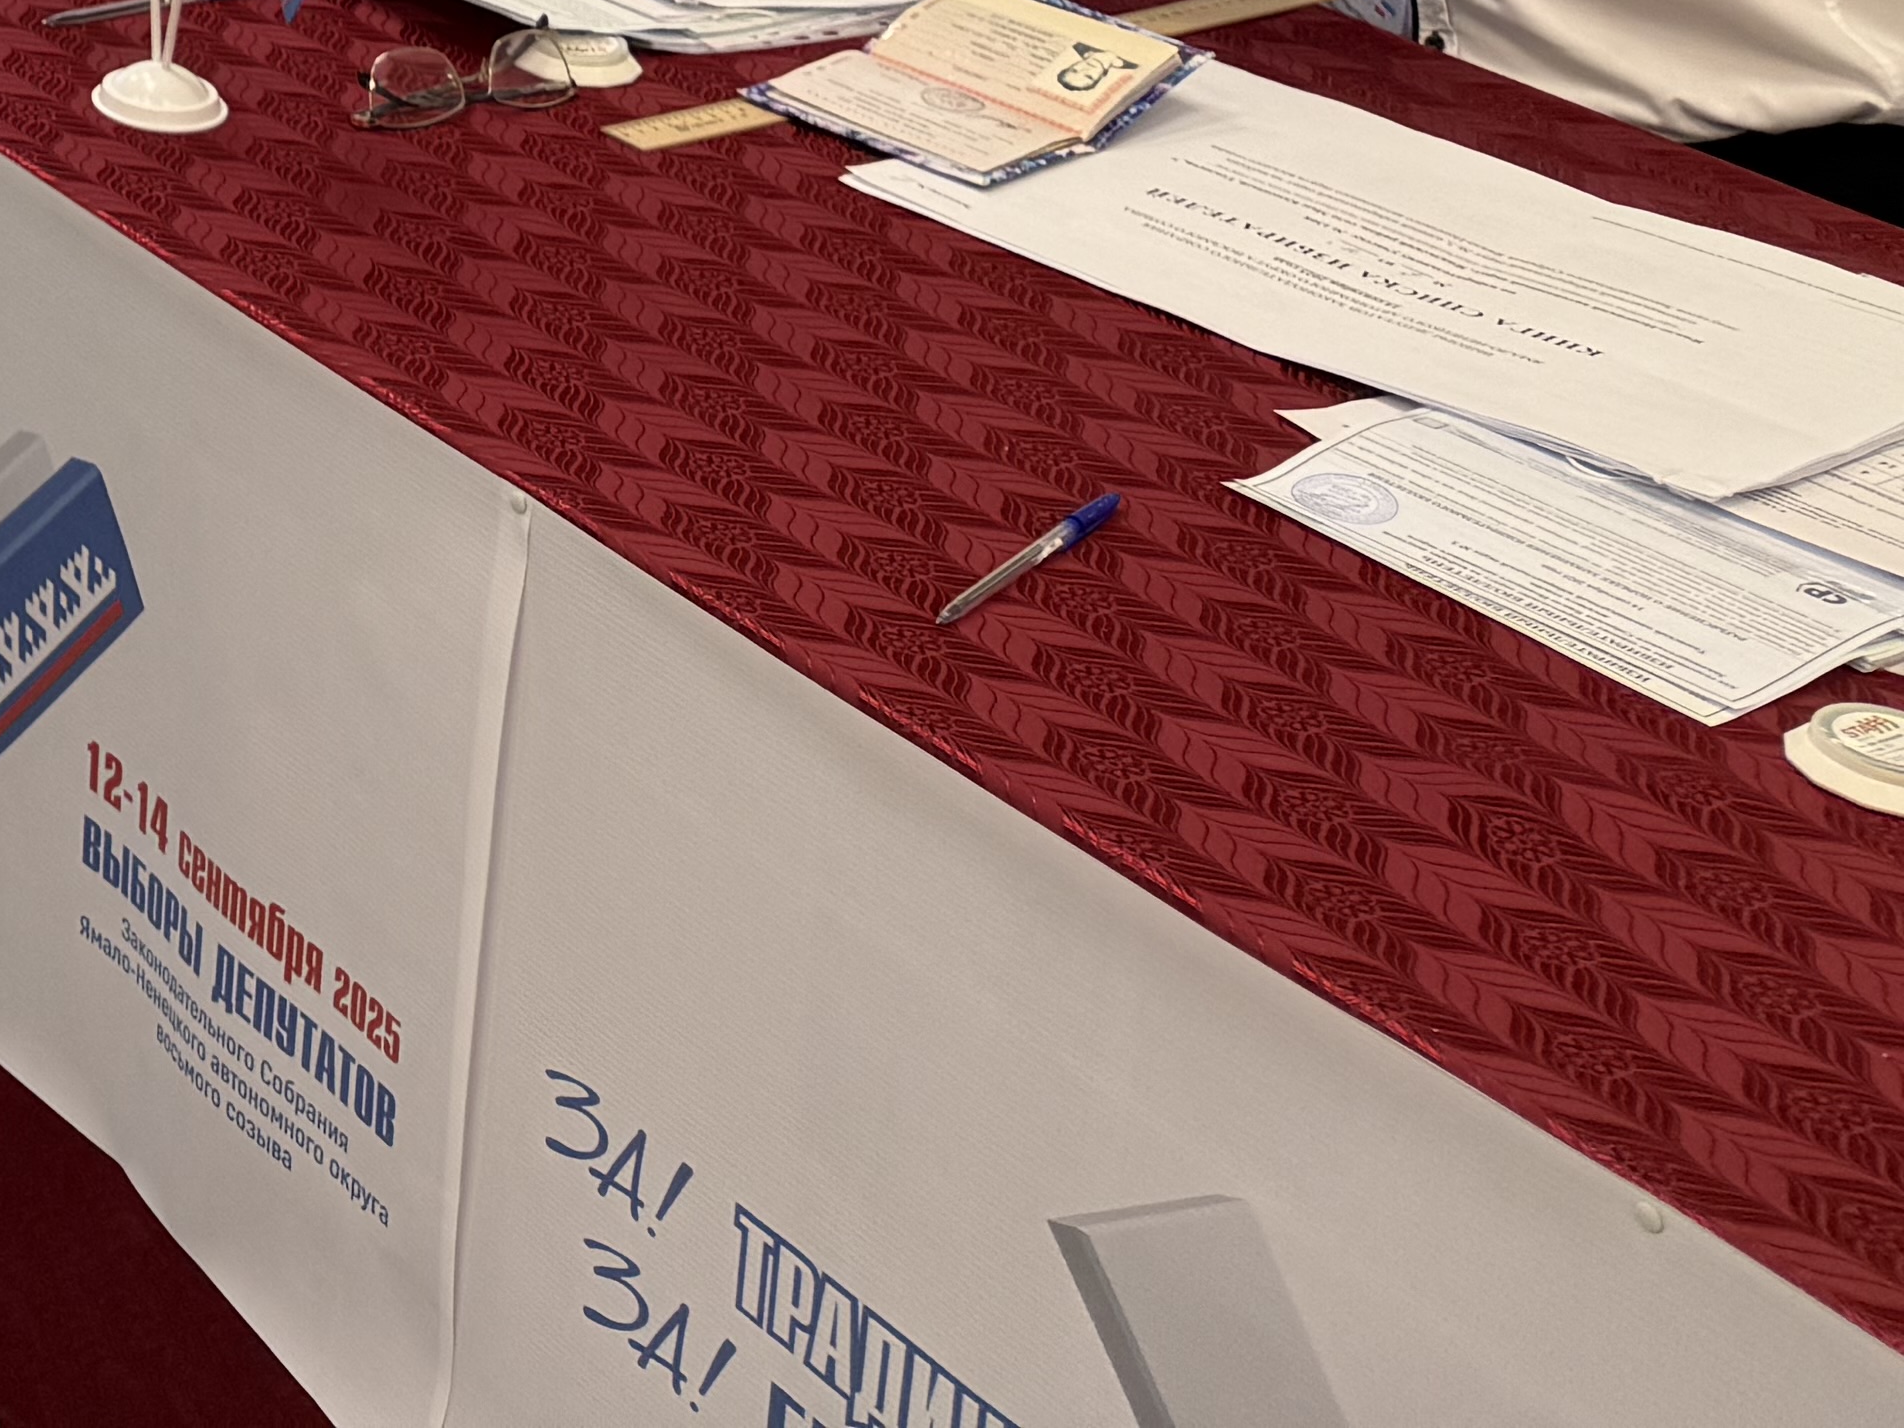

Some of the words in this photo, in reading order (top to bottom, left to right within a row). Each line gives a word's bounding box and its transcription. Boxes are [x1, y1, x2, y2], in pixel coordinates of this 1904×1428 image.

[1360, 269, 1484, 318] СПИСКА
[1495, 316, 1604, 358] КНИГА
[82, 814, 203, 978] ВЫБОРЫ
[211, 943, 397, 1148] ДЕПУТАТОВ
[86, 741, 169, 854] 12-14
[178, 830, 323, 994] сентября
[332, 966, 401, 1065] 2025
[78, 914, 206, 1063] Ямало-Ненецкого
[210, 1055, 325, 1168] автономного
[328, 1161, 390, 1228] округа
[121, 916, 255, 1074] Законодательного
[259, 1058, 350, 1154] Собрания
[155, 1022, 221, 1111] восьмого
[225, 1102, 294, 1173] созыва
[544, 1069, 694, 1237] ЗА!
[734, 1202, 1022, 1428] ТРАДИ
[583, 1237, 737, 1414] ЗА!
